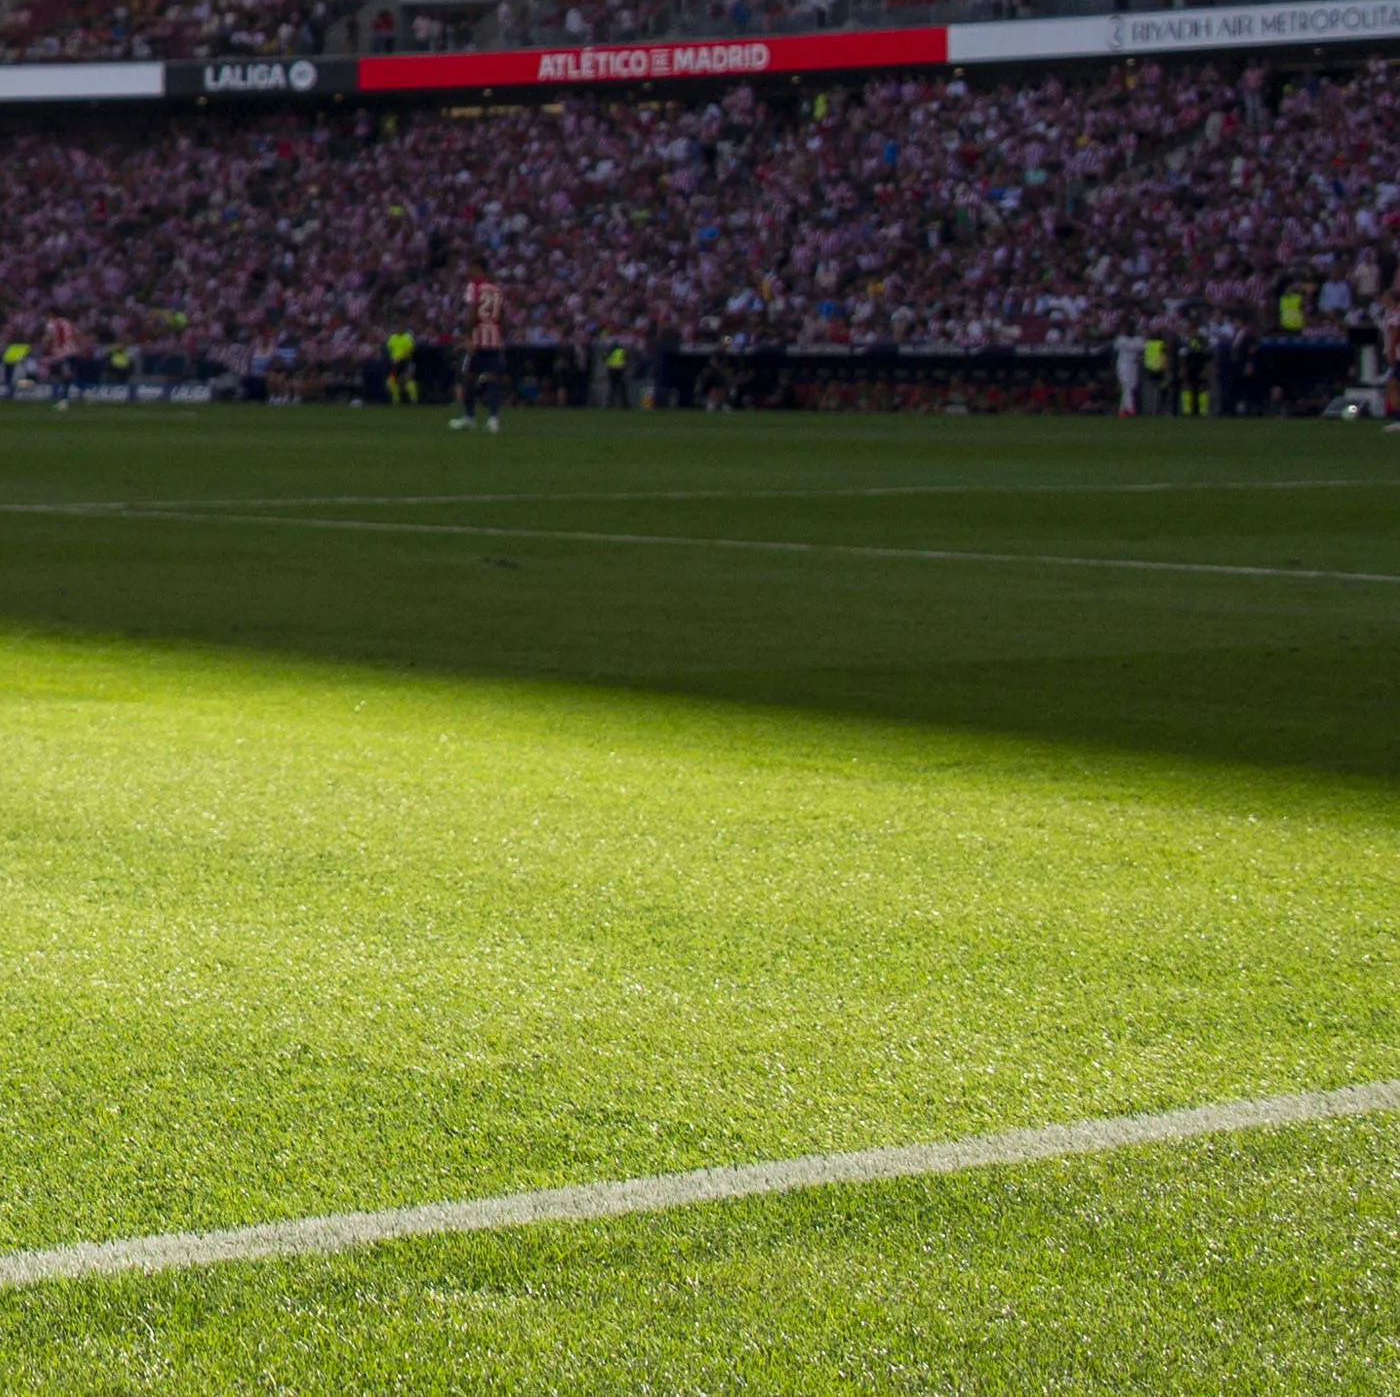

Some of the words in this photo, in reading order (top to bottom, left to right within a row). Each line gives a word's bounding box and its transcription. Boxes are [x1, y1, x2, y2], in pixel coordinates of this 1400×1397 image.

[204, 63, 288, 92] LALIGA
[537, 47, 649, 81] ATLÉTICO
[672, 43, 770, 72] MADRID
